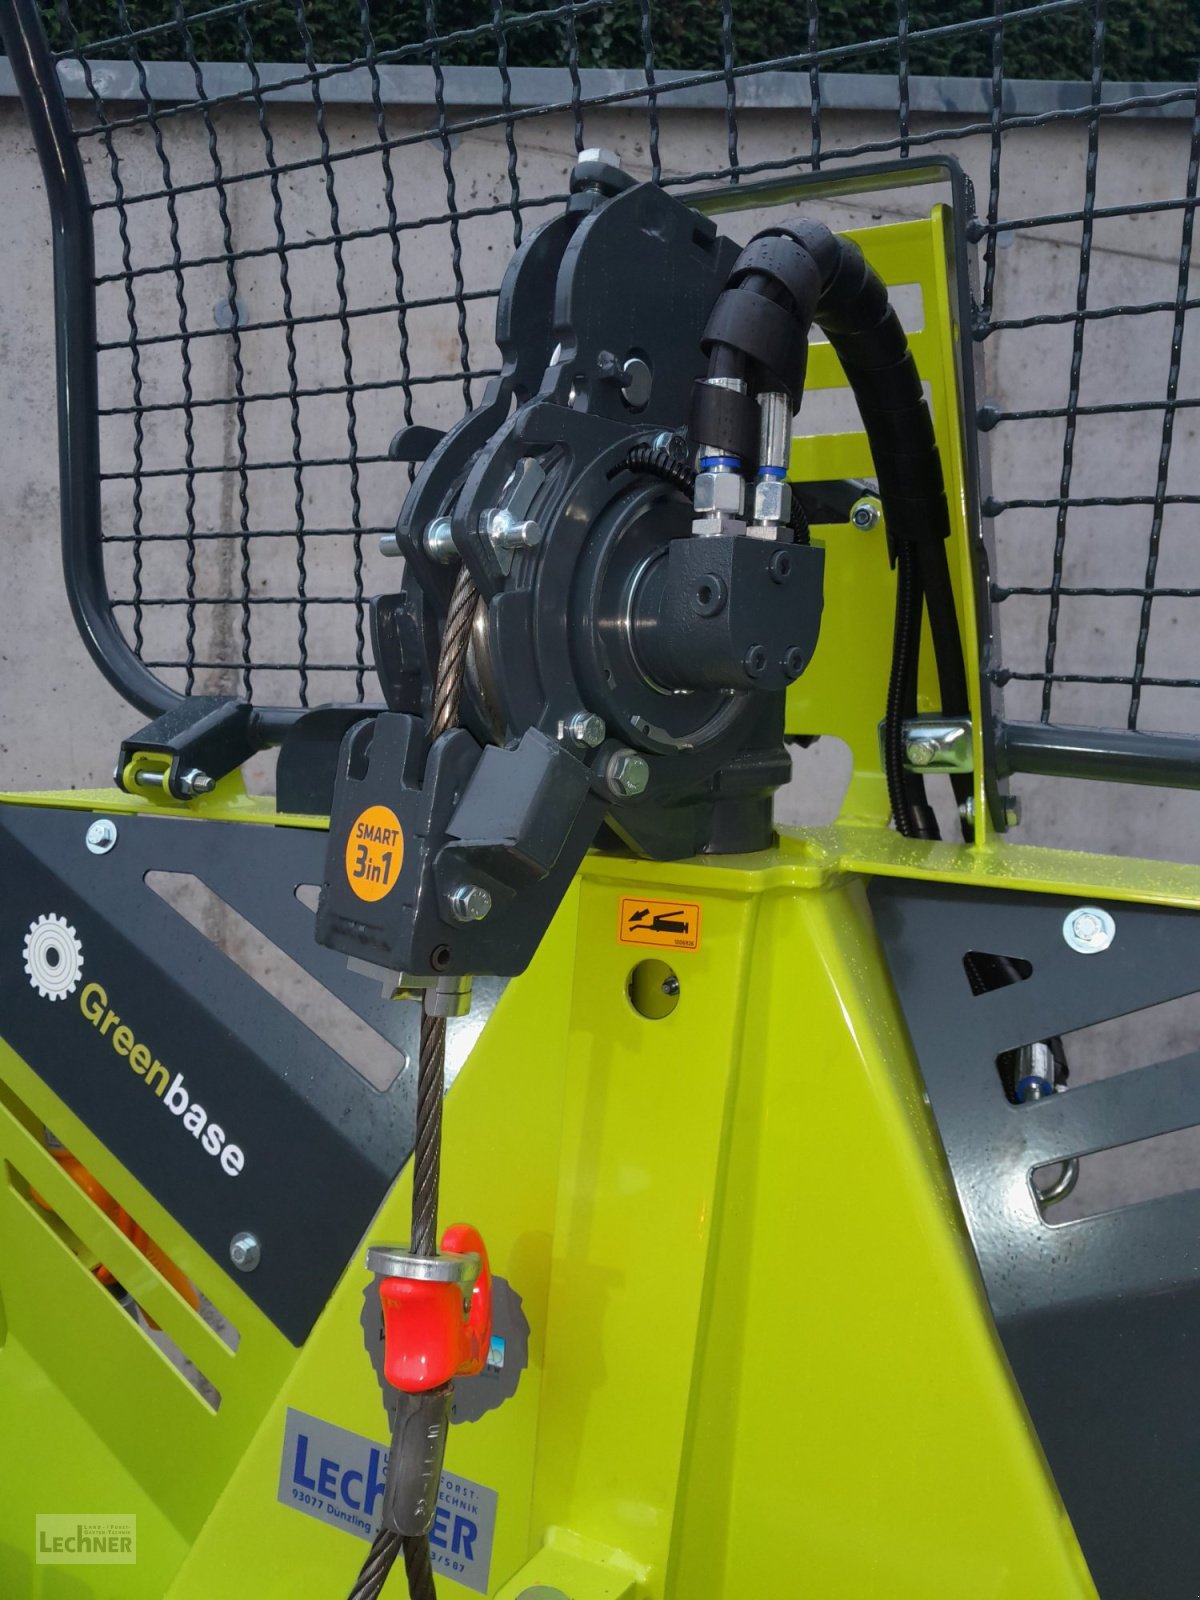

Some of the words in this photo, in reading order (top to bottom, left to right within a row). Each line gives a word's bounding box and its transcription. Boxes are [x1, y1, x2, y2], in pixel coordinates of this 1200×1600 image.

[355, 822, 400, 847] SMART
[353, 844, 393, 885] 3in1
[80, 982, 245, 1177] Greenbase
[291, 1488, 324, 1509] 93077
[439, 1491, 478, 1515] ECHNIK
